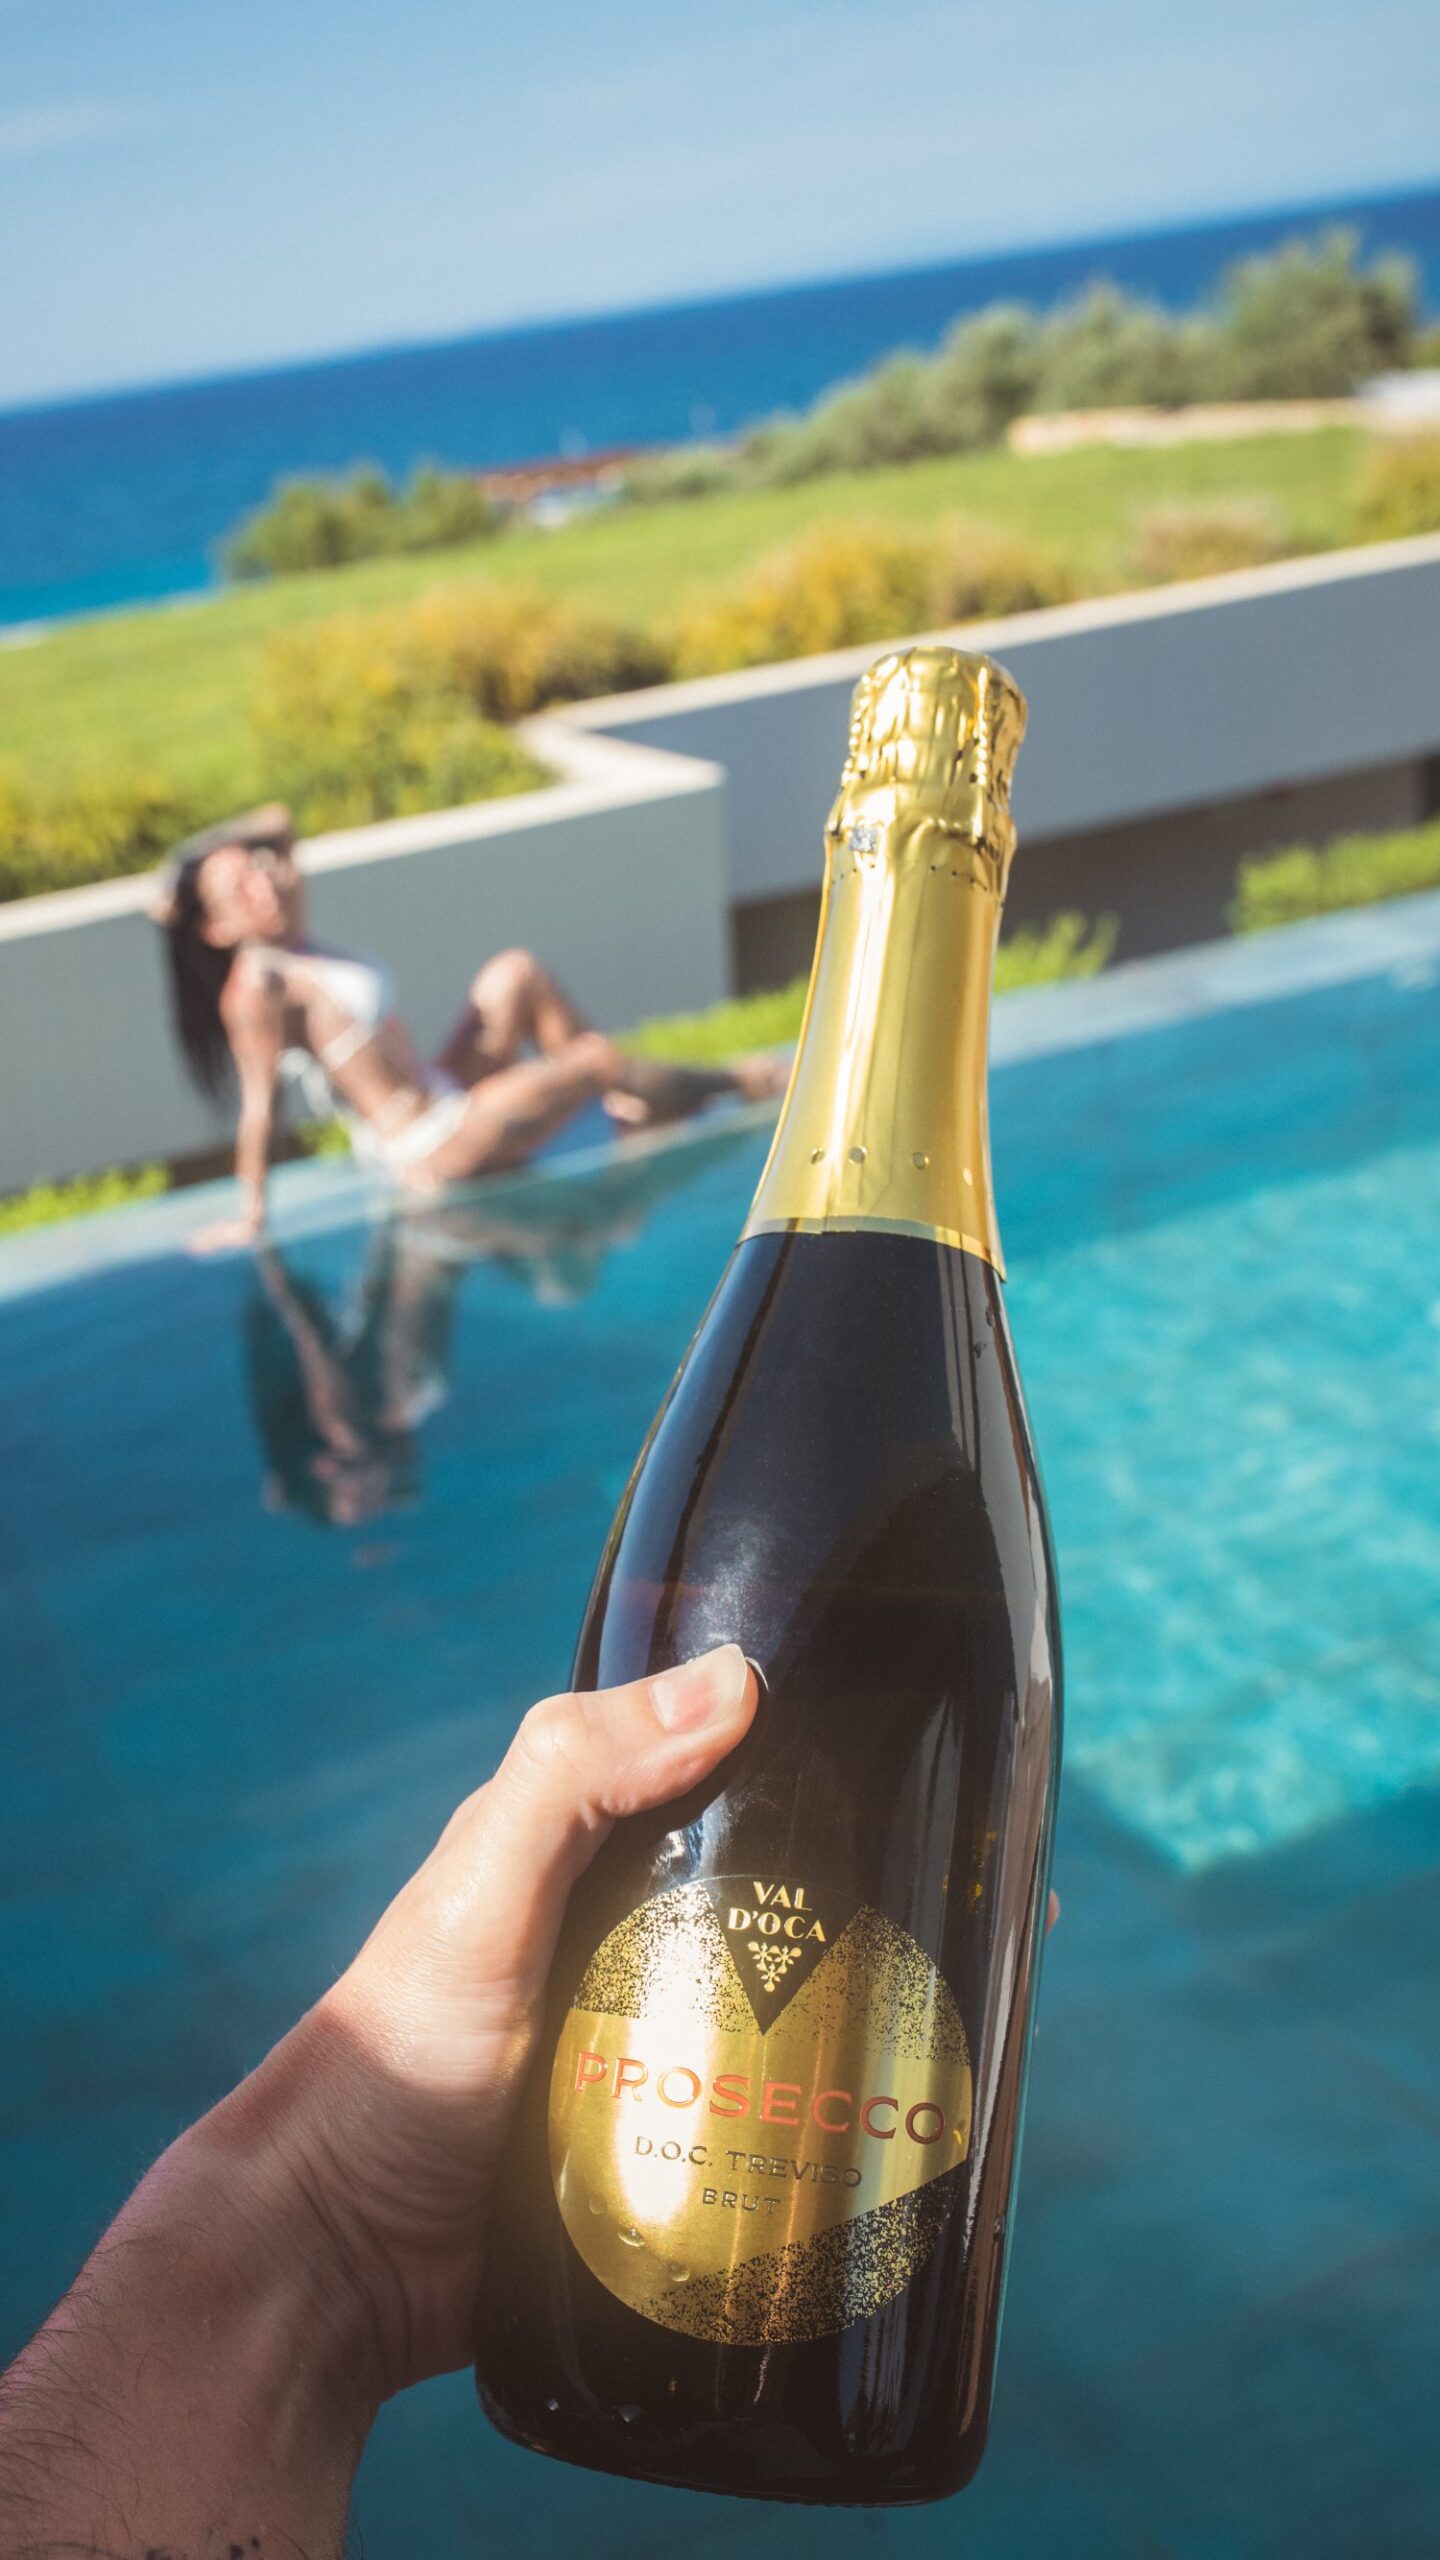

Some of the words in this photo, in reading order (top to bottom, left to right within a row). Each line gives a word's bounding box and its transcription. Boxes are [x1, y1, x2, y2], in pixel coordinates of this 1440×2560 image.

[753, 1881, 812, 1911] VAL
[728, 1907, 826, 1942] D'OCA
[574, 2051, 945, 2145] PROSECCO
[635, 2136, 713, 2167] D.O.C.
[725, 2150, 863, 2188] TREVISO
[702, 2187, 781, 2215] BRUT
